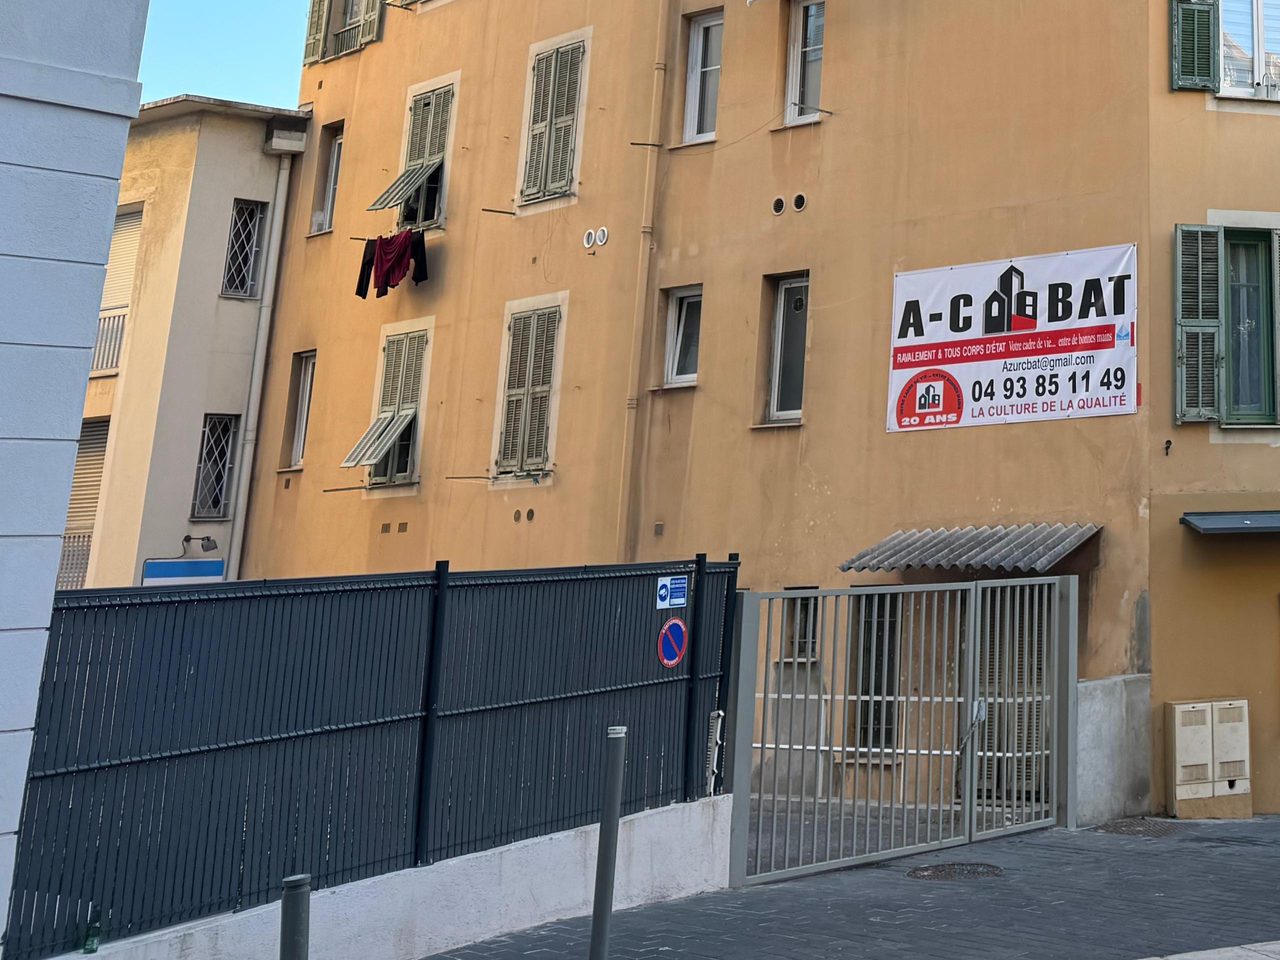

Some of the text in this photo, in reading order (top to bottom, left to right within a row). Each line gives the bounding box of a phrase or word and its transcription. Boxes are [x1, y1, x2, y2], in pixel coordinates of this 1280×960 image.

[1047, 274, 1132, 323] BAT
[1009, 340, 1022, 351] Votre
[1022, 338, 1036, 350] cadre
[1037, 338, 1043, 349] de
[1058, 336, 1071, 347] entre
[1071, 334, 1078, 345] de
[1078, 333, 1095, 344] bonnes
[1097, 330, 1112, 342] mains
[897, 349, 937, 363] RAVALEMENT
[945, 347, 961, 358] TOUS
[962, 344, 984, 356] CORPS
[986, 341, 1006, 354] D'ÉTAT
[1002, 354, 1095, 373] Azurcbat@gmail.com
[971, 378, 995, 402] 04
[1003, 376, 1027, 400] 93
[1035, 373, 1059, 397] 85
[1068, 370, 1090, 394] 11
[1100, 367, 1126, 391] 49
[971, 392, 1126, 419] LA CULTURE DE LA QUALITÉ
[901, 413, 958, 426] 20 ANS
